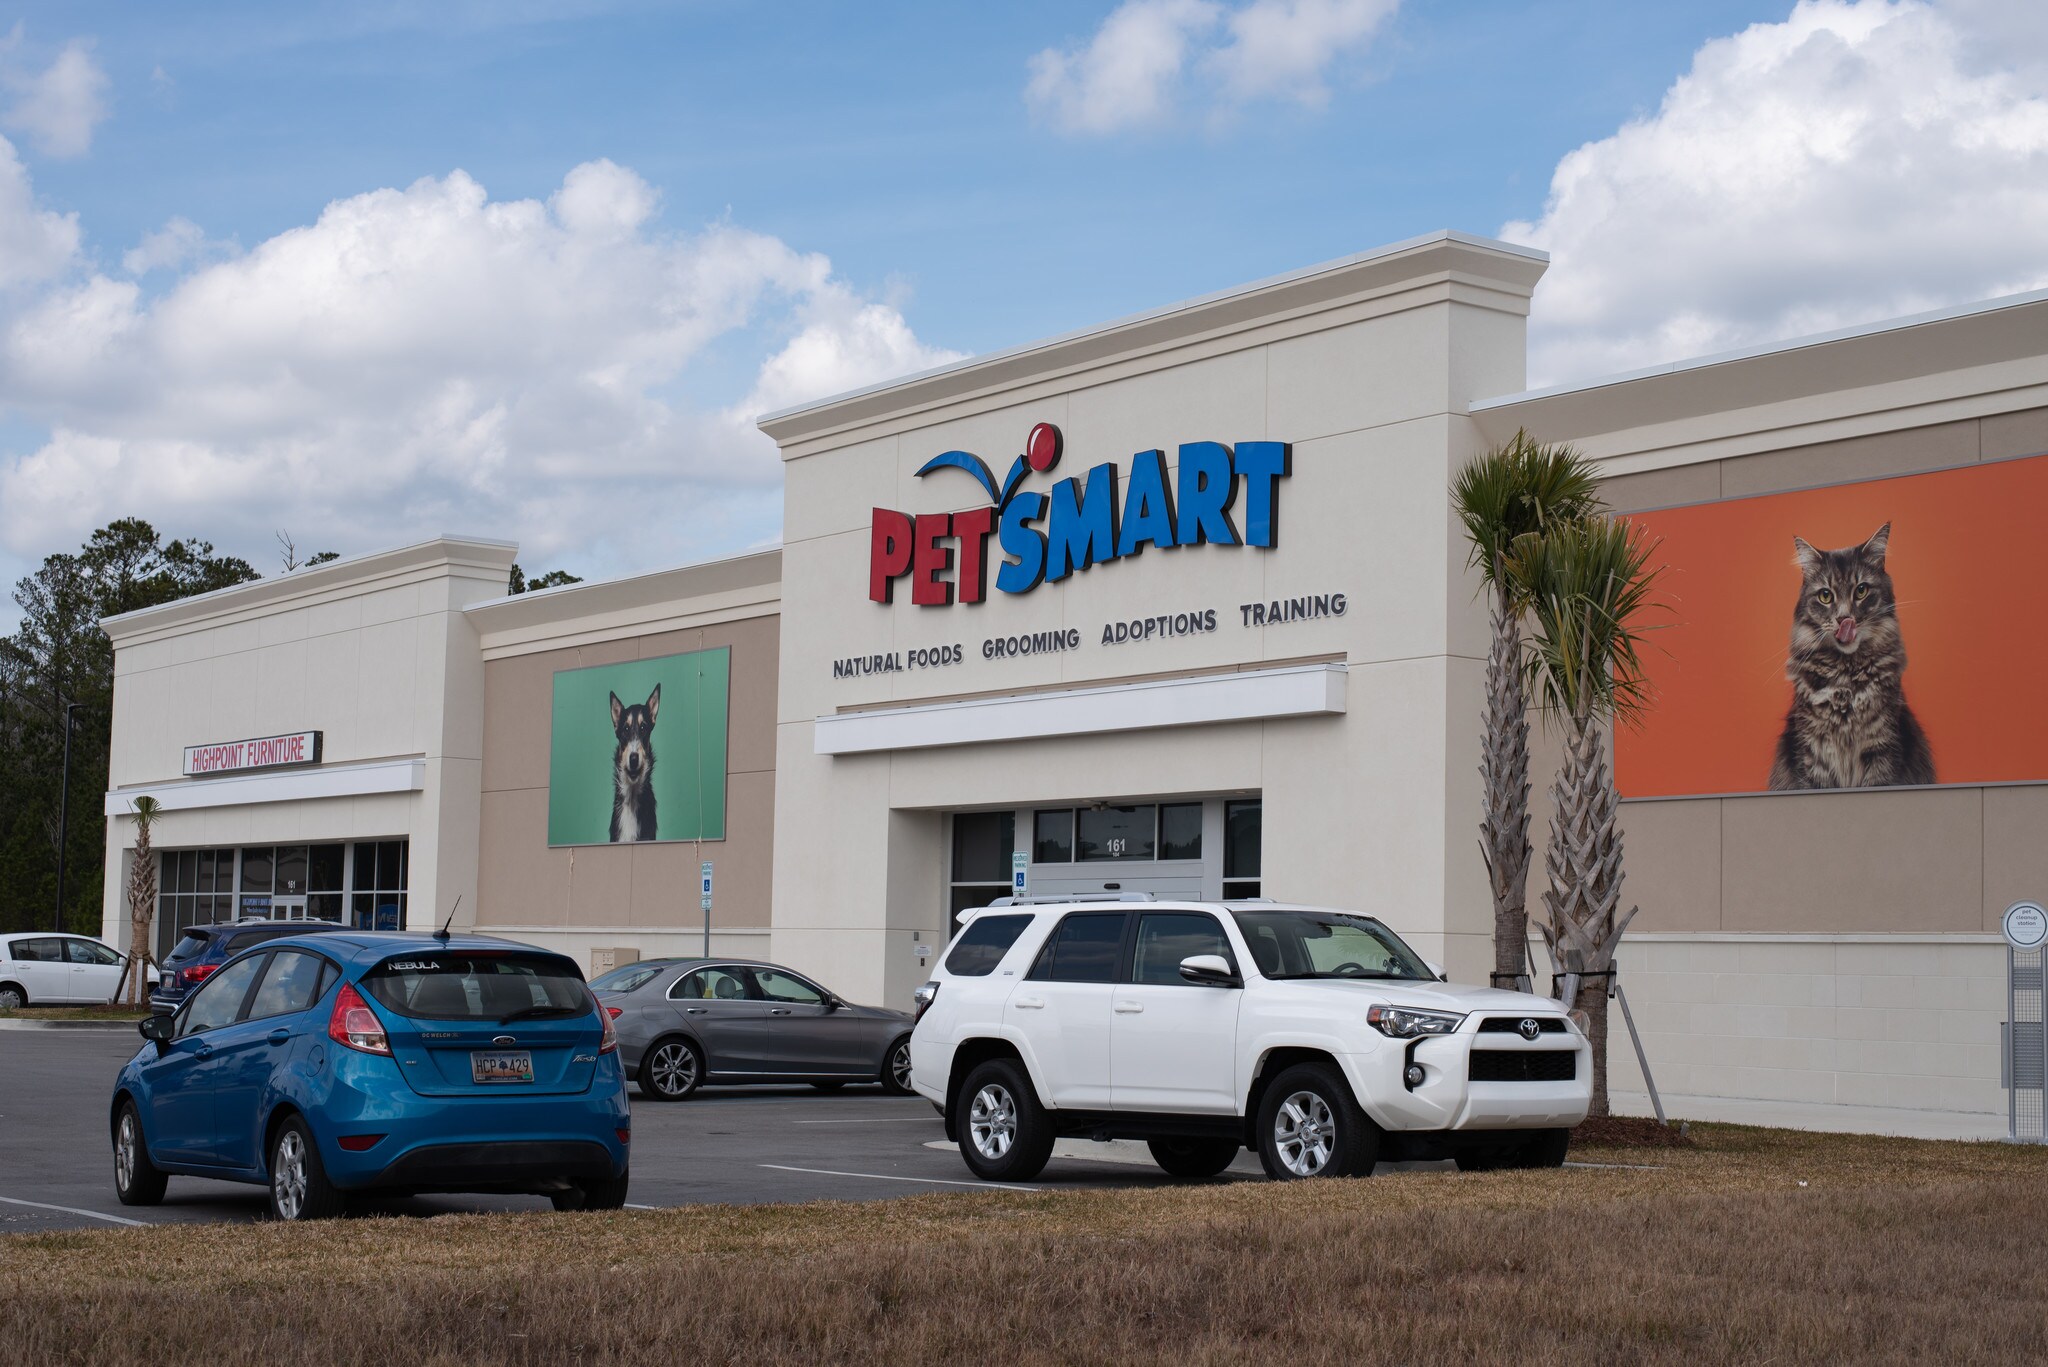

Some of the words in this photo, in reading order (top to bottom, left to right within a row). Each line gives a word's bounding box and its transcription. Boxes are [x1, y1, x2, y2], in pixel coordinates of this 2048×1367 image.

[869, 441, 1292, 605] PETSMART
[833, 652, 903, 678] NATURAL
[907, 643, 964, 669] FOODS
[982, 628, 1081, 660] GROOMING
[1101, 609, 1218, 645] ADOPTIONS
[1240, 593, 1348, 627] TRAINING
[192, 744, 244, 772] HIGHPOINT
[247, 736, 305, 766] FURNITURE
[1106, 838, 1125, 852] 161
[387, 961, 440, 971] NEBULA
[475, 1059, 497, 1074] HCP
[509, 1058, 529, 1073] 429
